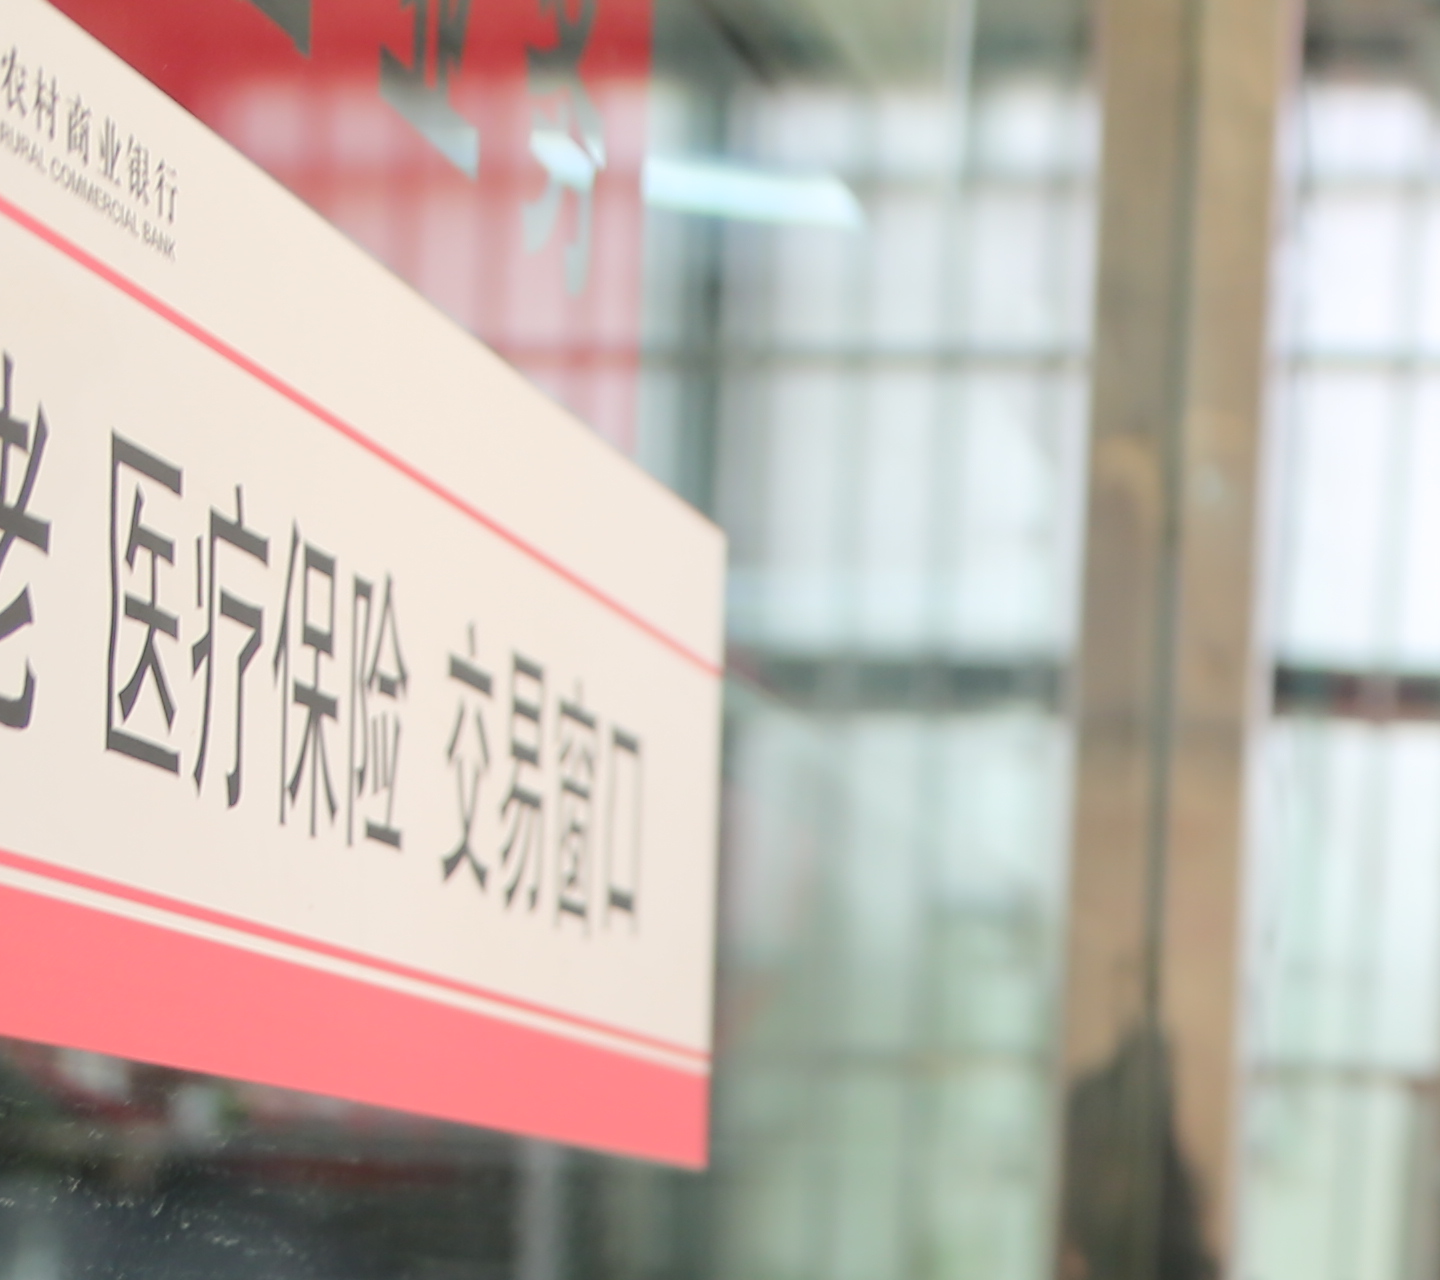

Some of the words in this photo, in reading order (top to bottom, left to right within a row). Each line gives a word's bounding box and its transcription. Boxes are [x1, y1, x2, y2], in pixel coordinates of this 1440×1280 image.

[49, 156, 140, 239] COMMERCIAL
[142, 218, 178, 261] BANK
[105, 427, 410, 850] 医疗保险
[440, 621, 645, 938] 交易窗口
